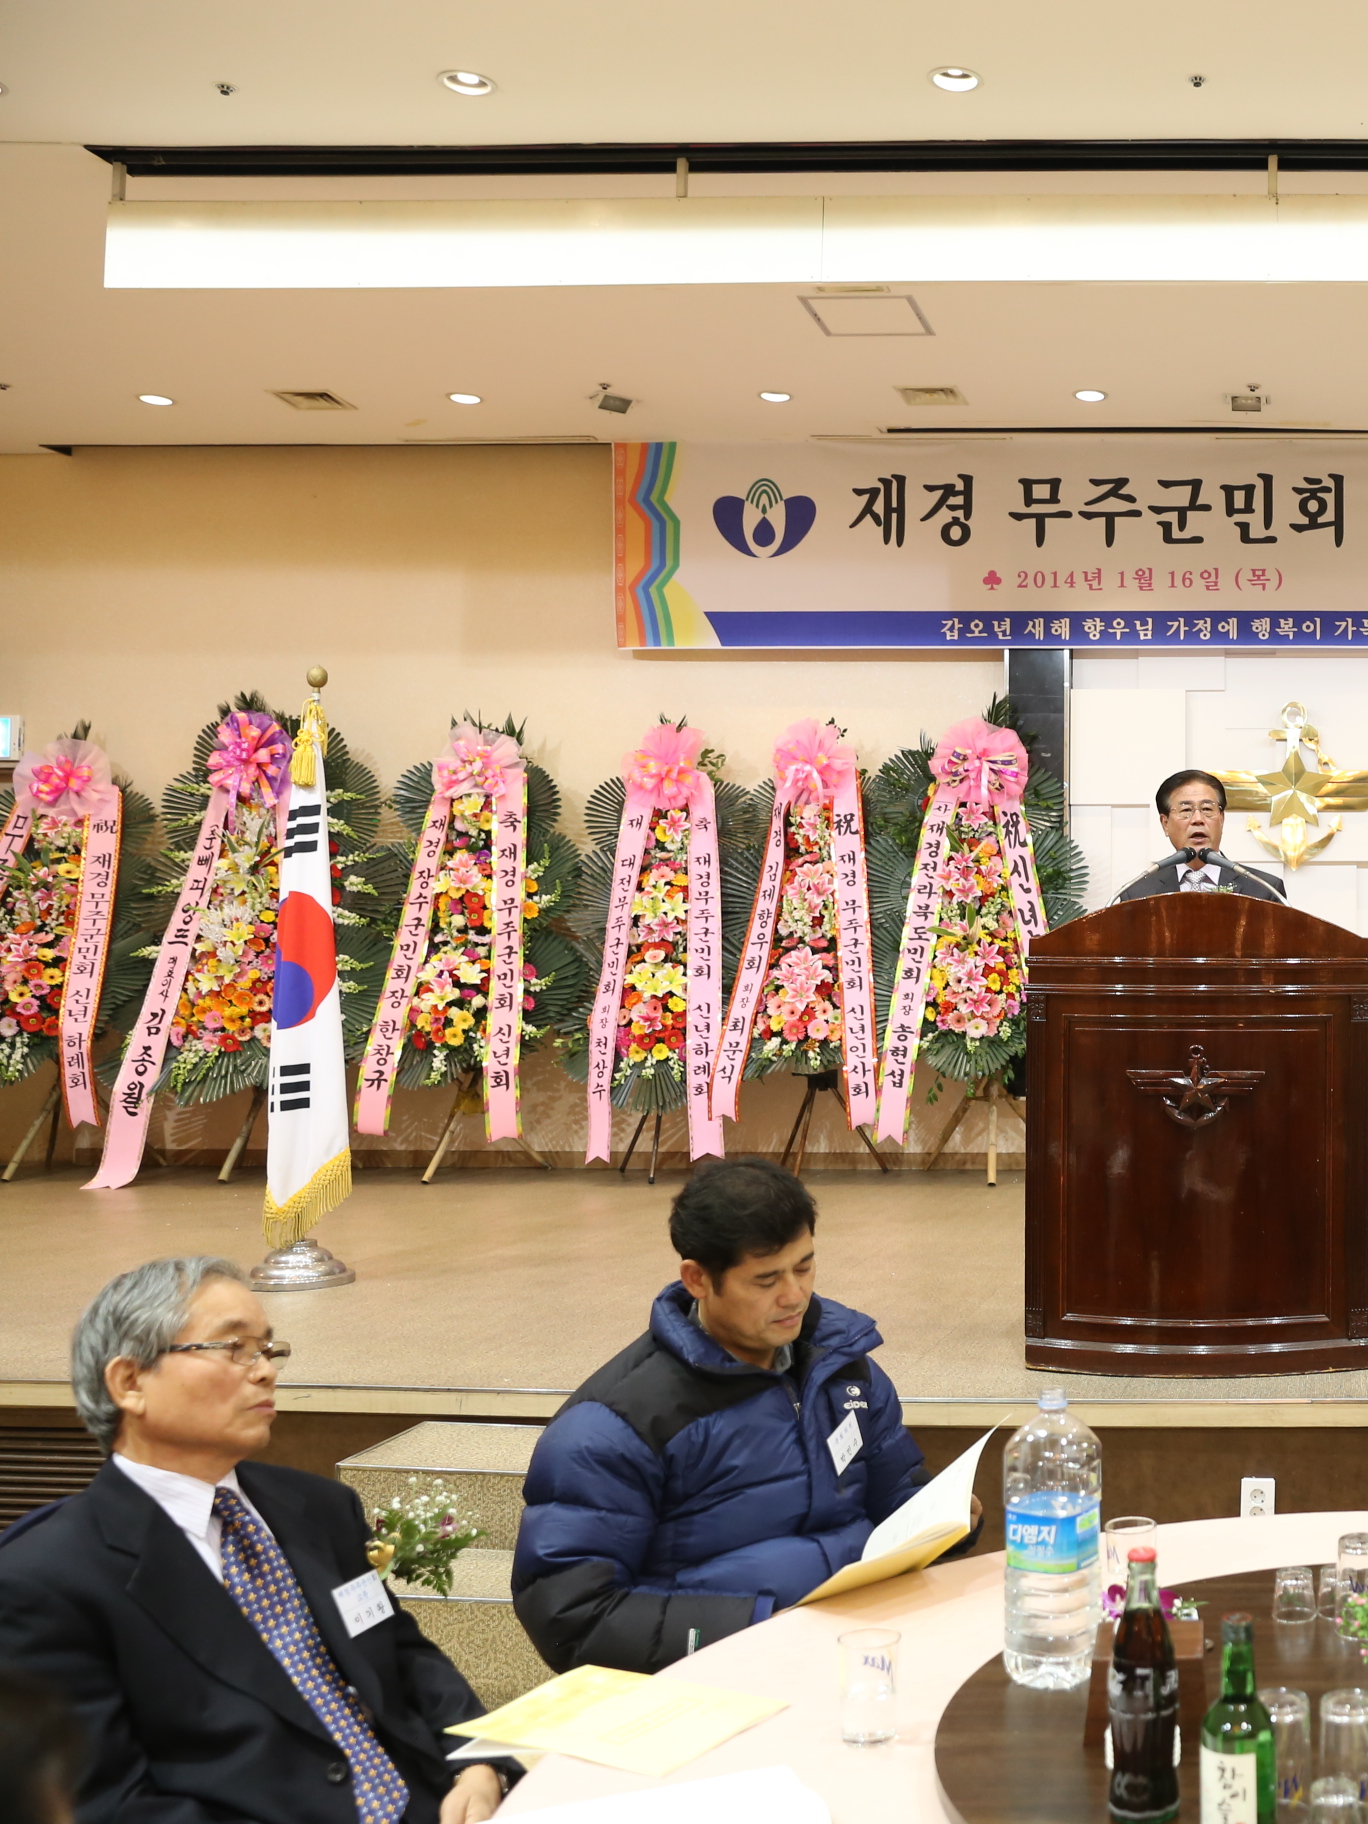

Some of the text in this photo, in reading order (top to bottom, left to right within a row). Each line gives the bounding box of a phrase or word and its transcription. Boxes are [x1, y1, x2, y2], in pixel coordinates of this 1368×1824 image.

[848, 472, 977, 549] 재경
[1007, 472, 1346, 550] 무주군민회
[1016, 567, 1284, 593] 2014년 1월 16일 (목)
[940, 617, 1013, 642] 갑오년
[1024, 617, 1072, 642] 새해
[1083, 617, 1156, 642] 향우님
[1165, 617, 1239, 642] 가정에
[1250, 617, 1322, 642] 행복이
[92, 819, 117, 835] 祝
[422, 815, 447, 858] 재경
[499, 810, 521, 833] 축
[695, 816, 711, 833] 축
[834, 812, 860, 836] 祝
[1001, 810, 1028, 850] 祝
[717, 802, 783, 1085] 재경 김제향우회 회장 최문식
[598, 1005, 610, 1029] 회장
[899, 991, 915, 1016] 회장
[364, 1019, 400, 1092] 한창규
[490, 1023, 512, 1093] 신년회
[592, 1036, 609, 1102] 천상수
[692, 1002, 714, 1097] 신년하례회
[846, 1004, 872, 1099] 신년인사회
[884, 1023, 915, 1089] 송현섭
[1008, 1523, 1057, 1545] 디엠지
